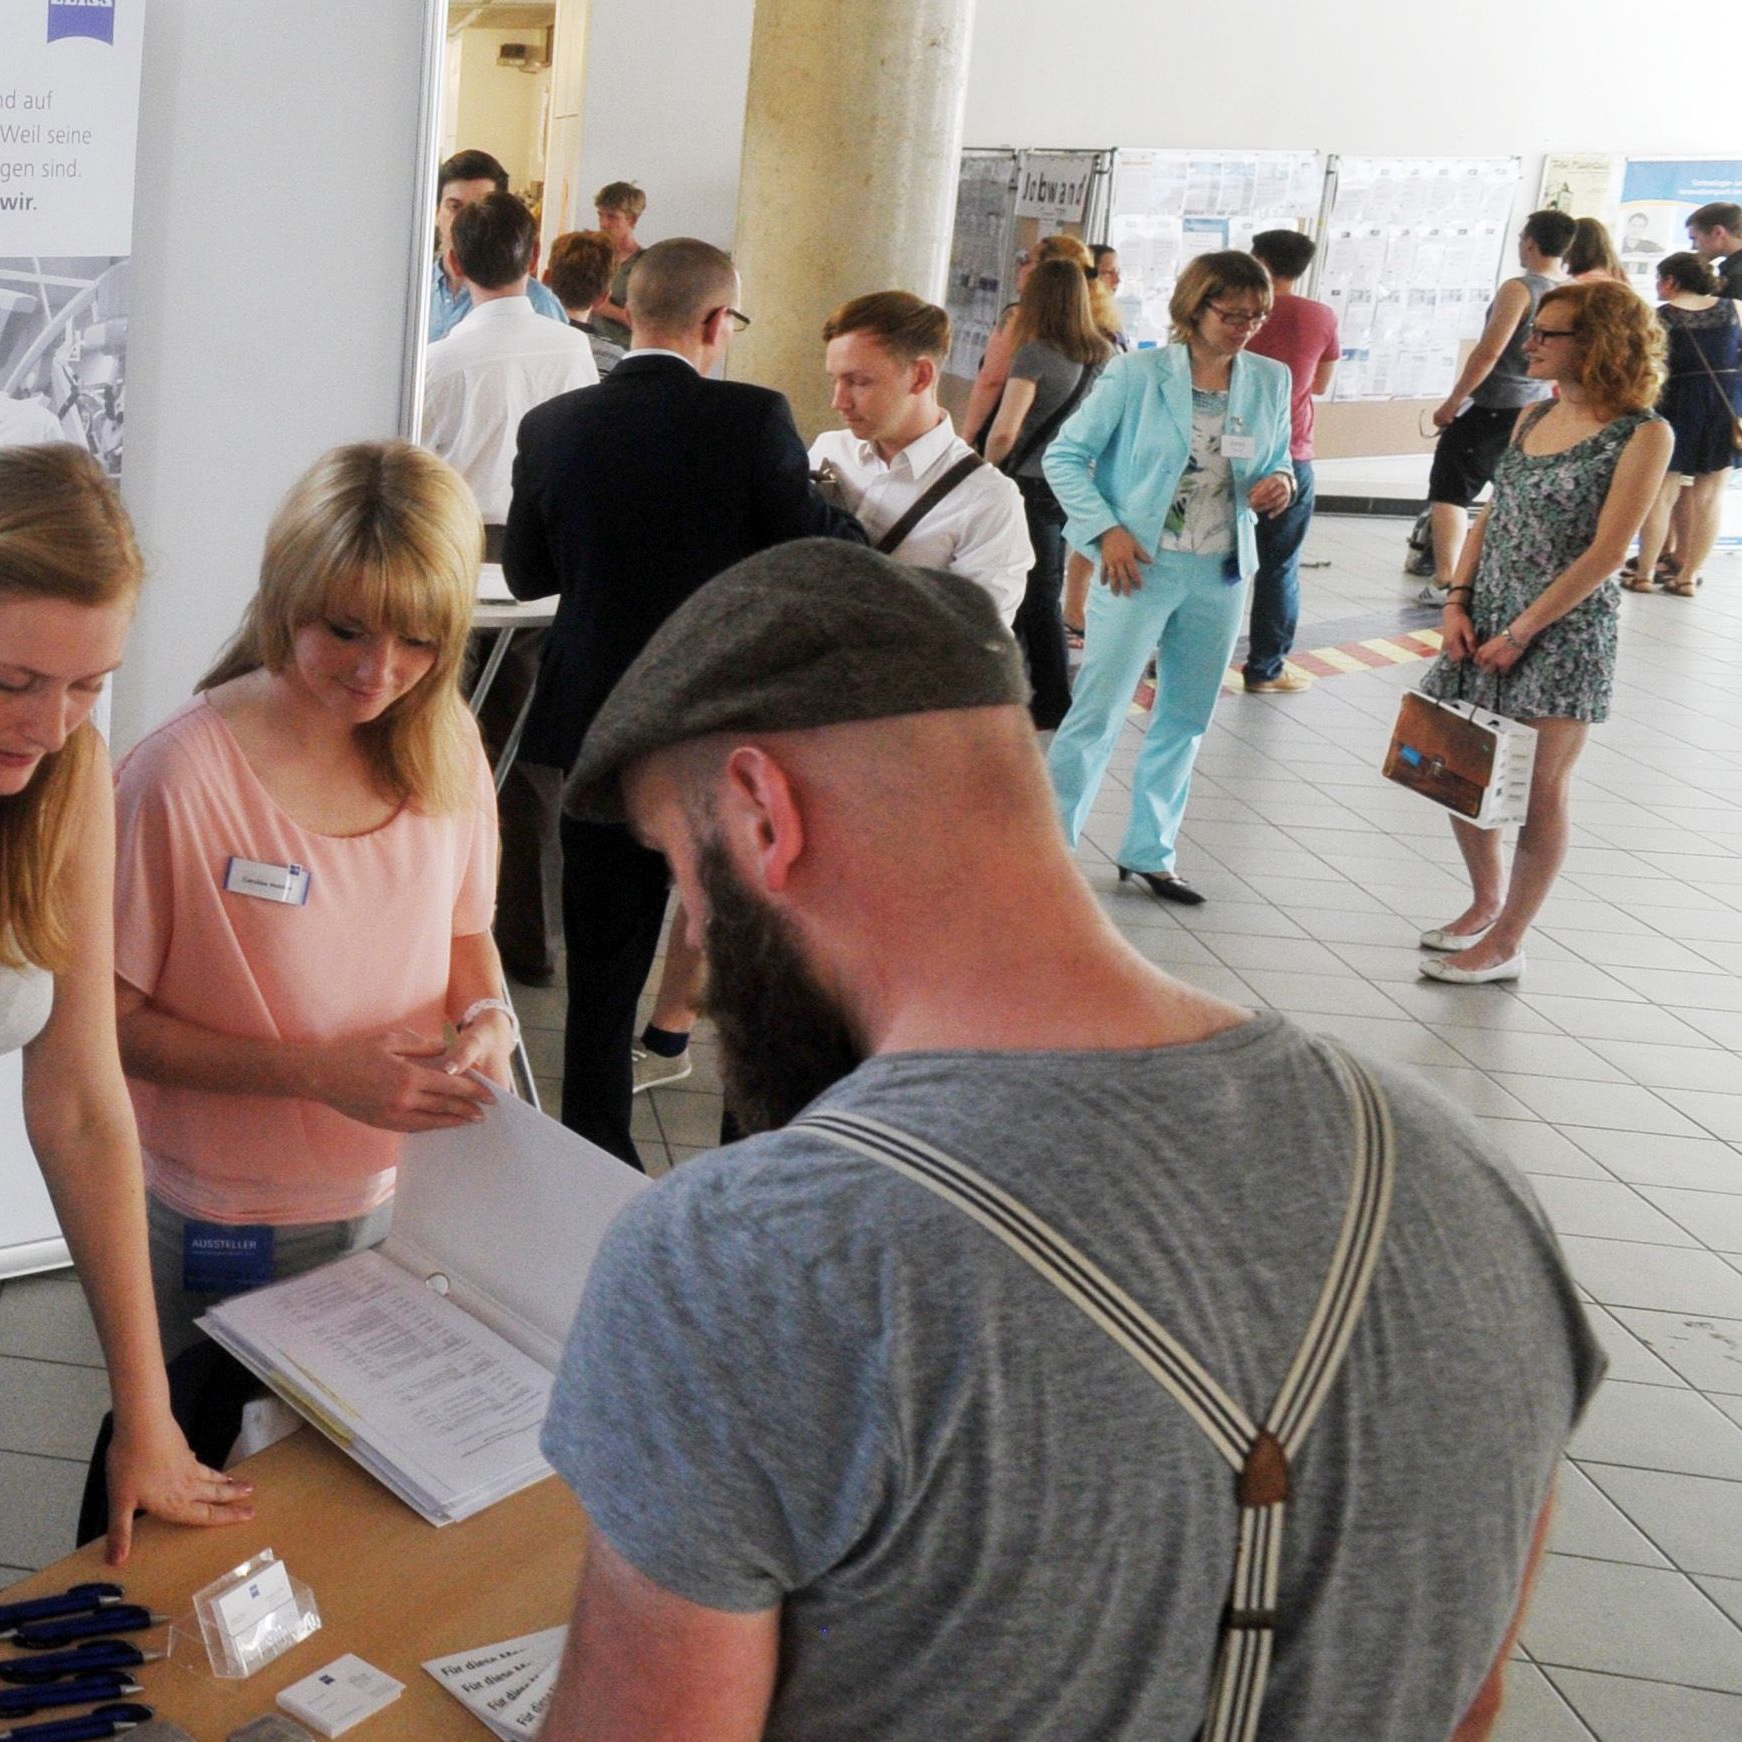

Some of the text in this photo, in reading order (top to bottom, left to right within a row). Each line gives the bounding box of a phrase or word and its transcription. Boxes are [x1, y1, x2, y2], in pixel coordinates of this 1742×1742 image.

[23, 90, 53, 110] auf
[0, 124, 41, 144] Weil
[47, 125, 92, 145] seine
[41, 158, 81, 178] sind.
[1022, 172, 1087, 205] Jobwand
[0, 192, 37, 211] wir.
[192, 1239, 257, 1250] AUSSTELLER
[440, 1664, 463, 1677] Für
[461, 1681, 483, 1693] Für
[487, 1696, 507, 1711] Für
[516, 1711, 535, 1727] Für
